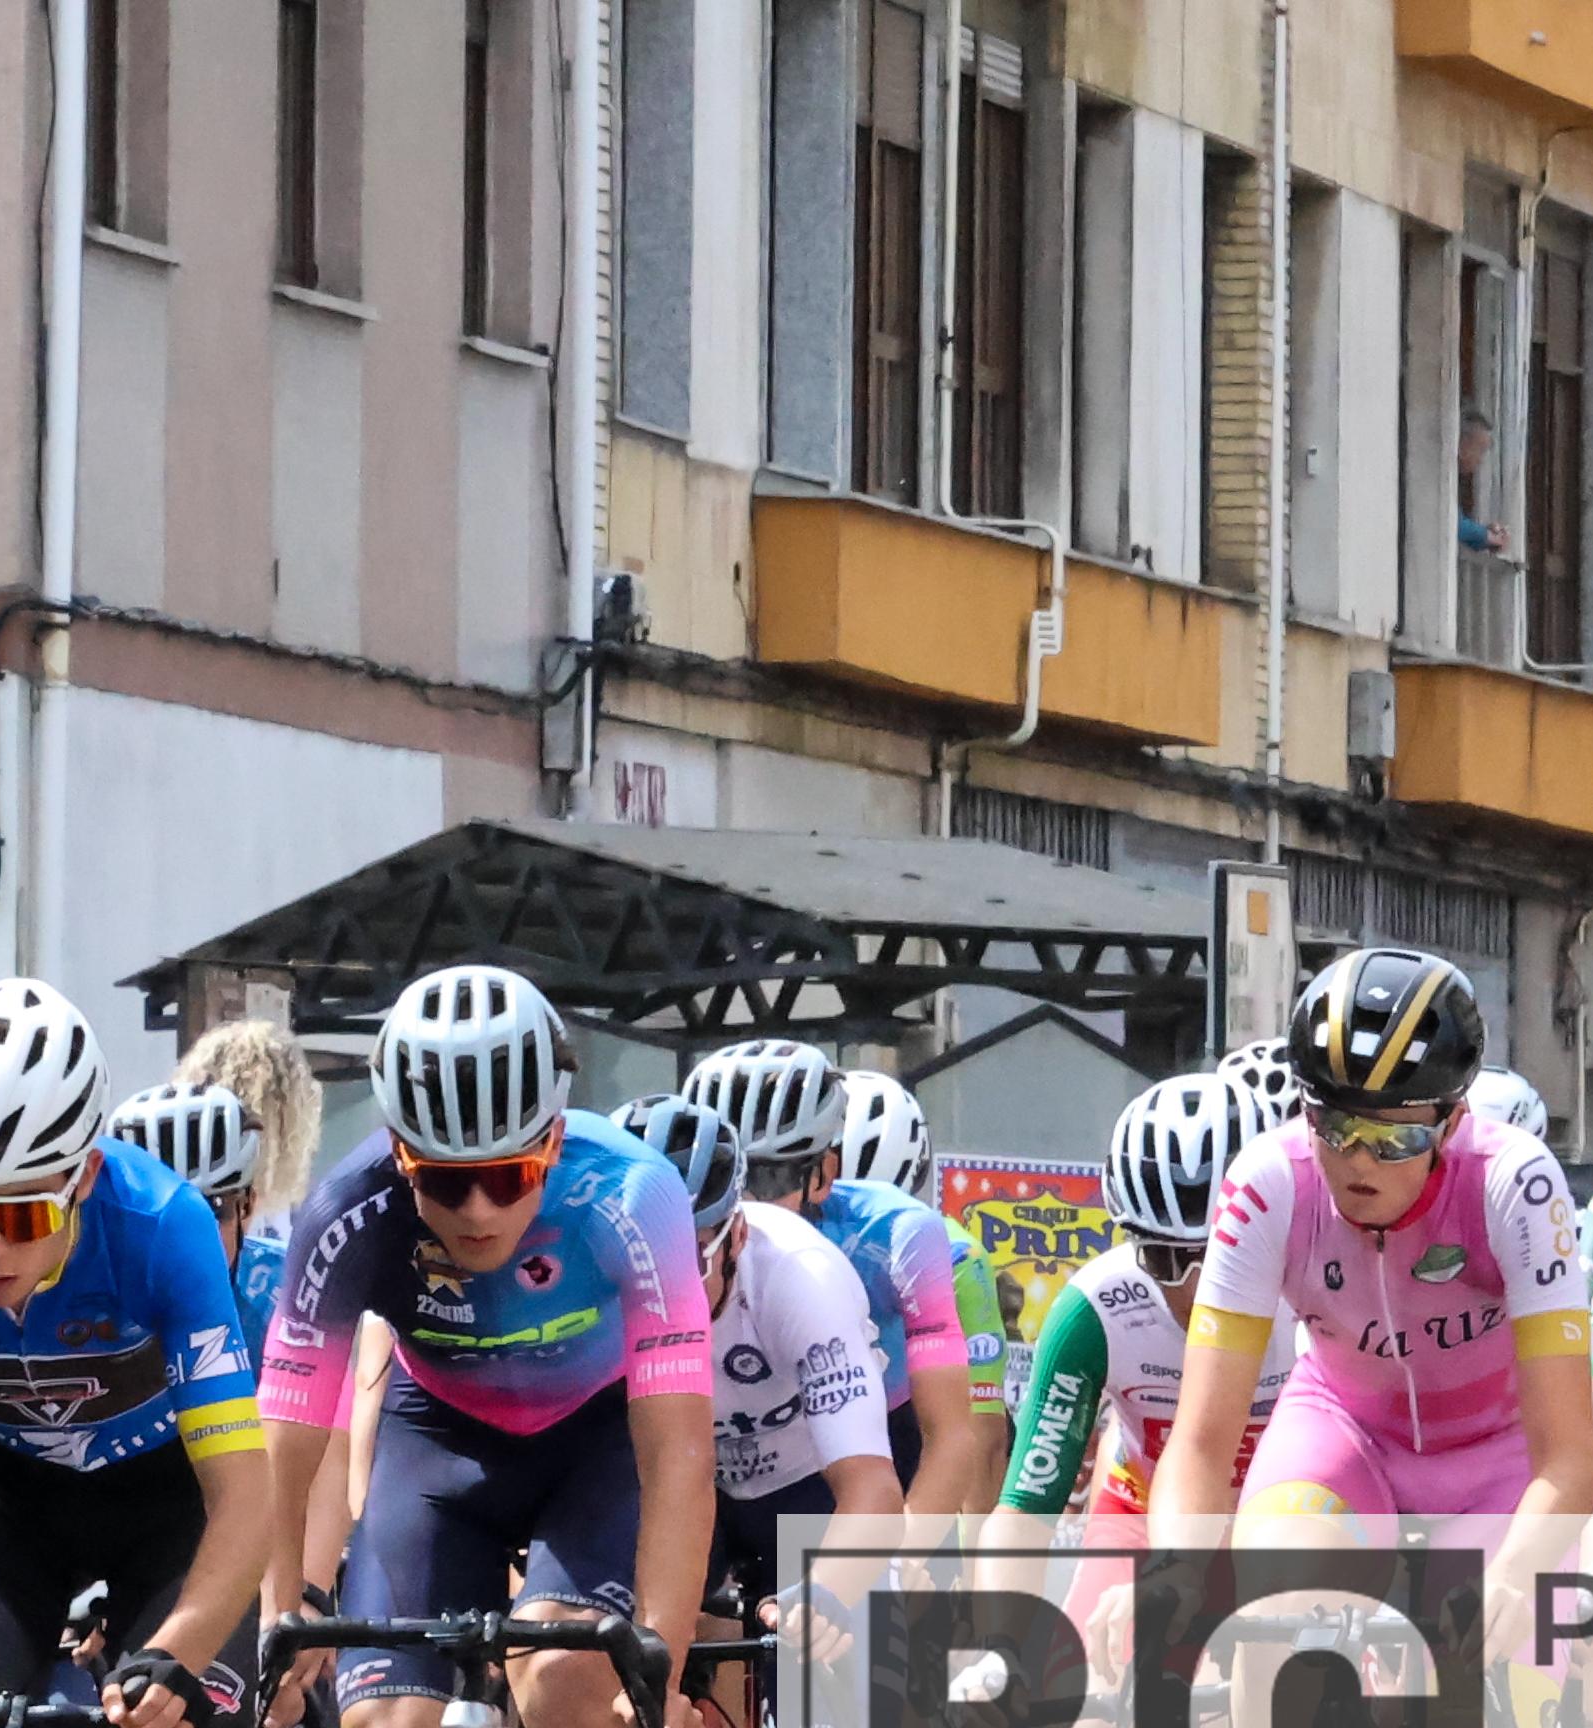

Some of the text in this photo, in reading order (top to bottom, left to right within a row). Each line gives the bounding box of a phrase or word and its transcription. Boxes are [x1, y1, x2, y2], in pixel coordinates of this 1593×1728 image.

[295, 1186, 393, 1322] SCOTT
[592, 1195, 669, 1324] SCOTT
[978, 1210, 1114, 1259] PRIN
[1514, 1155, 1573, 1286] LOGOS
[1098, 1279, 1150, 1308] solo
[1015, 1371, 1086, 1496] KOMETA
[1140, 1362, 1183, 1381] GSPO
